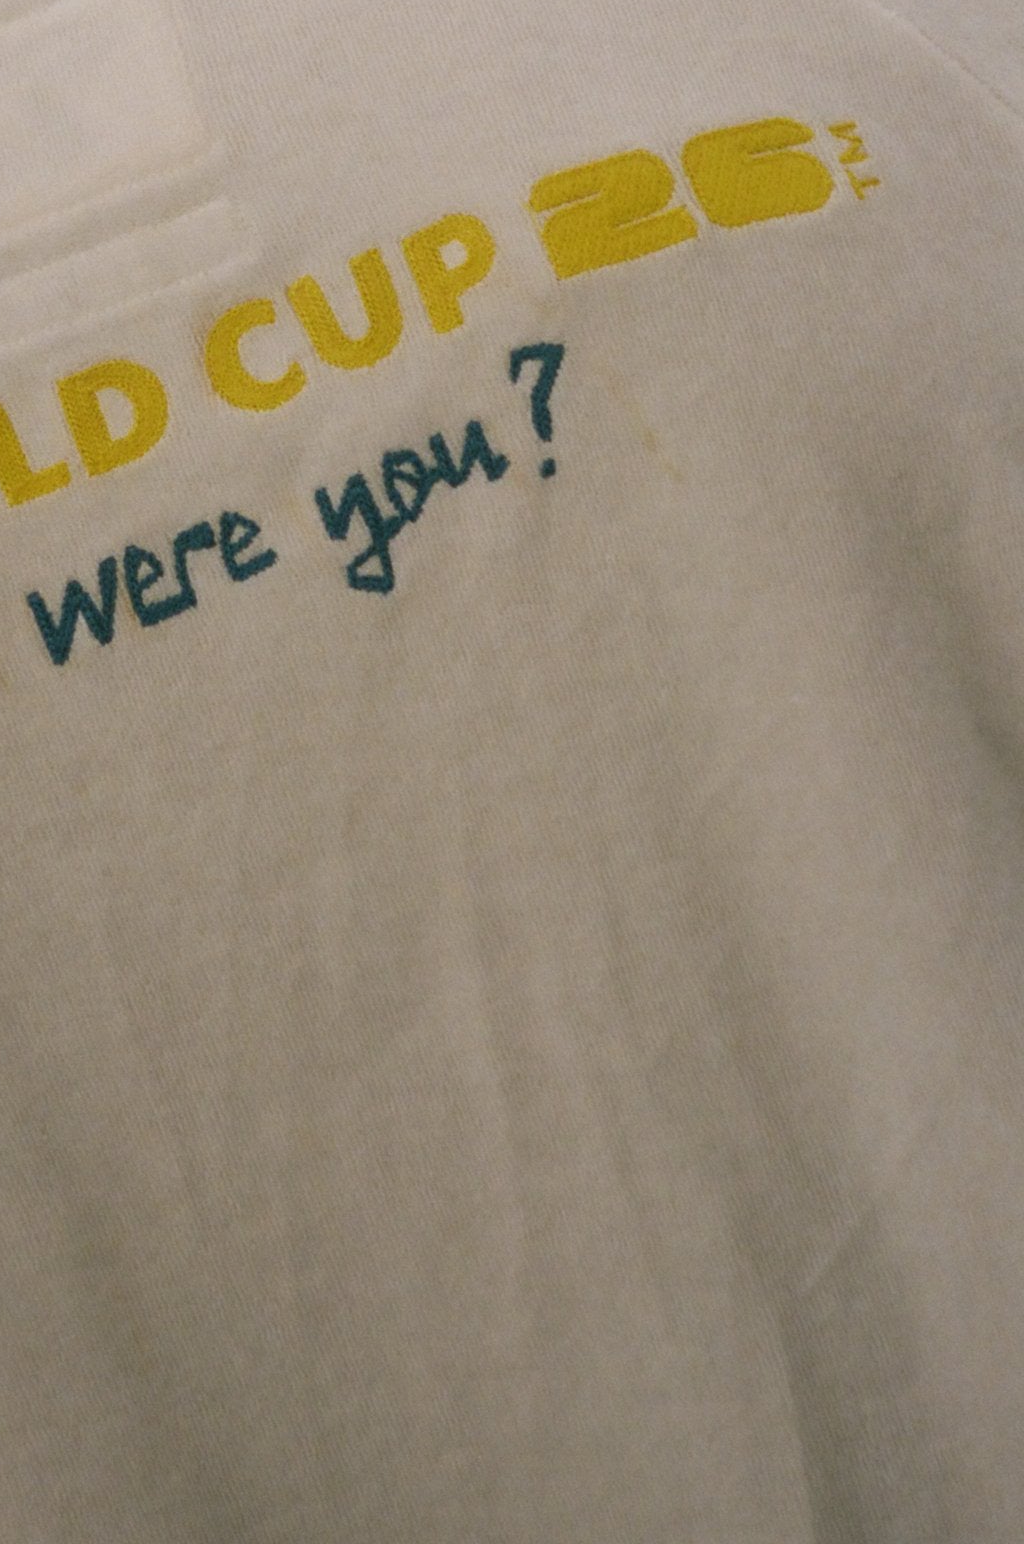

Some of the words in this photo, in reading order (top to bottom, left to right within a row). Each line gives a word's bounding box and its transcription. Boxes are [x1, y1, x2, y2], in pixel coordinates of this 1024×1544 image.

[203, 212, 497, 414] CUP
[26, 511, 277, 665] were
[315, 343, 566, 595] you?
